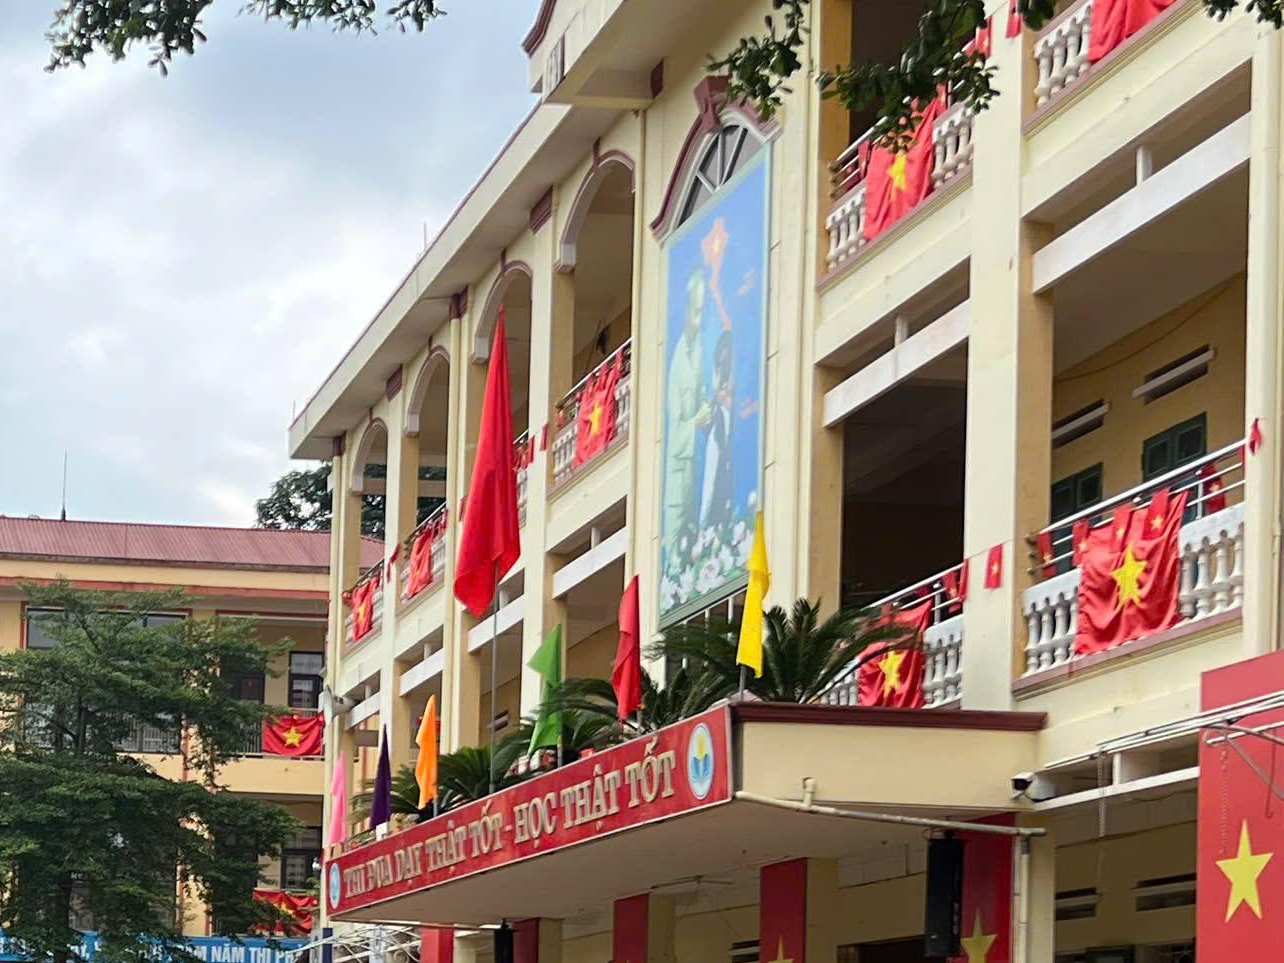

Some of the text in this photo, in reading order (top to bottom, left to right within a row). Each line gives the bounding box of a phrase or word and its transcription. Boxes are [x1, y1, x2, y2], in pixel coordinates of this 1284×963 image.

[343, 863, 366, 898] THI
[394, 842, 424, 886] DẠY
[425, 819, 467, 875] THẬT
[469, 799, 504, 858] TỐT
[513, 792, 558, 848] HỌC
[560, 763, 621, 831] THẬT
[624, 735, 677, 808] TỐT
[211, 943, 245, 963] NĂM
